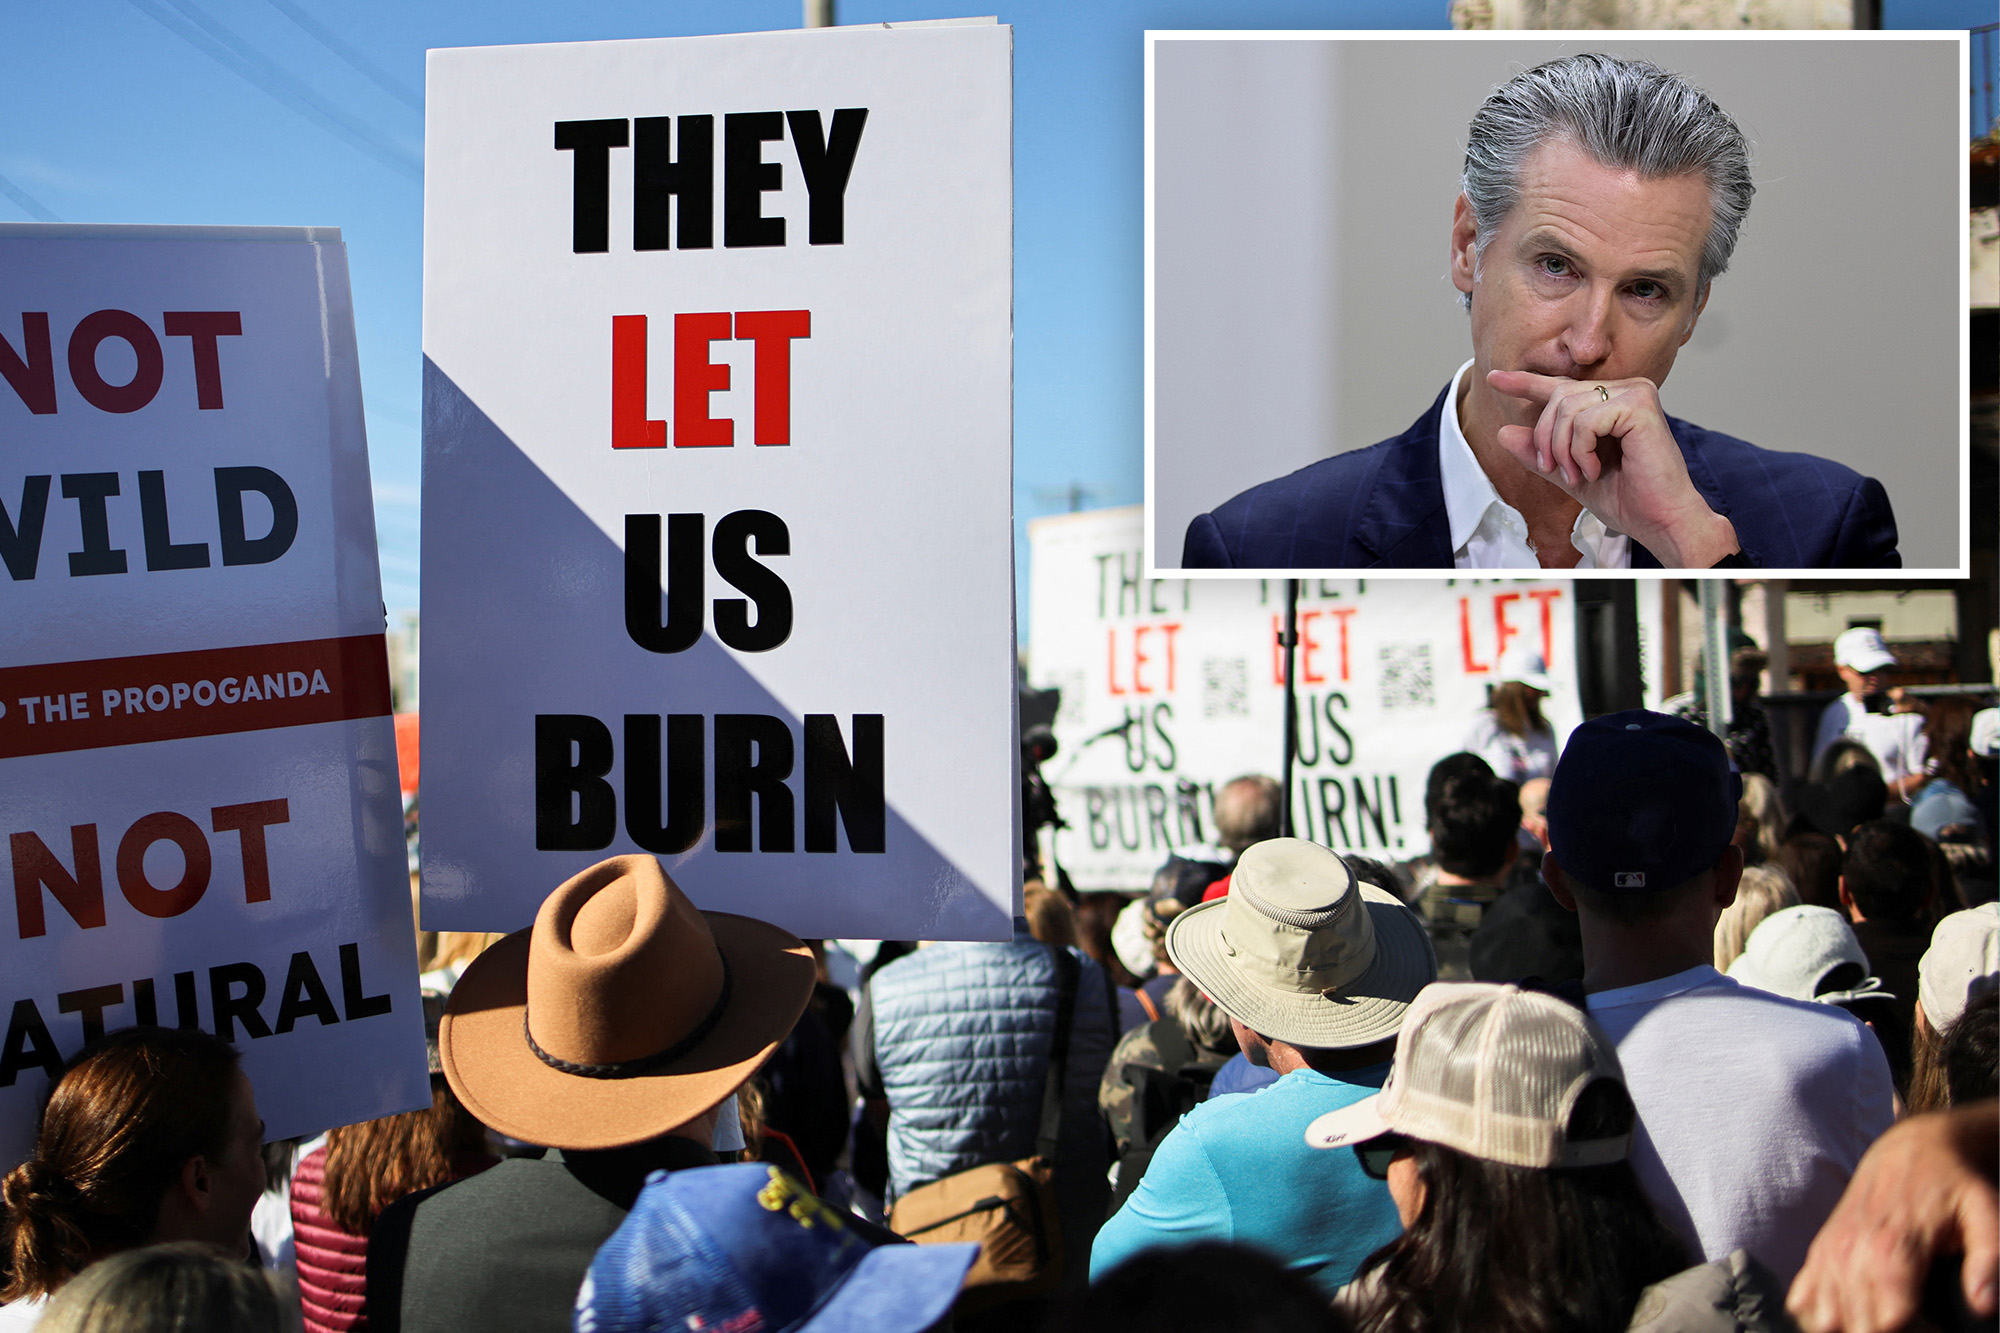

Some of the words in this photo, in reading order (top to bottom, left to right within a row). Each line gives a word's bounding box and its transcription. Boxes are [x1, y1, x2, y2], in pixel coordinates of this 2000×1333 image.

[553, 107, 869, 254] THEY
[0, 309, 242, 415] NOT
[611, 309, 811, 450] LET
[624, 508, 794, 654] US
[18, 691, 90, 725] THE
[102, 668, 331, 717] PROPOGANDA
[1108, 622, 1182, 696] LET
[1272, 607, 1357, 686] LET
[535, 713, 886, 855] BURN
[1124, 703, 1176, 773] US
[1294, 692, 1354, 767] US
[9, 797, 290, 940] NOT
[0, 942, 392, 1087] ATURAL
